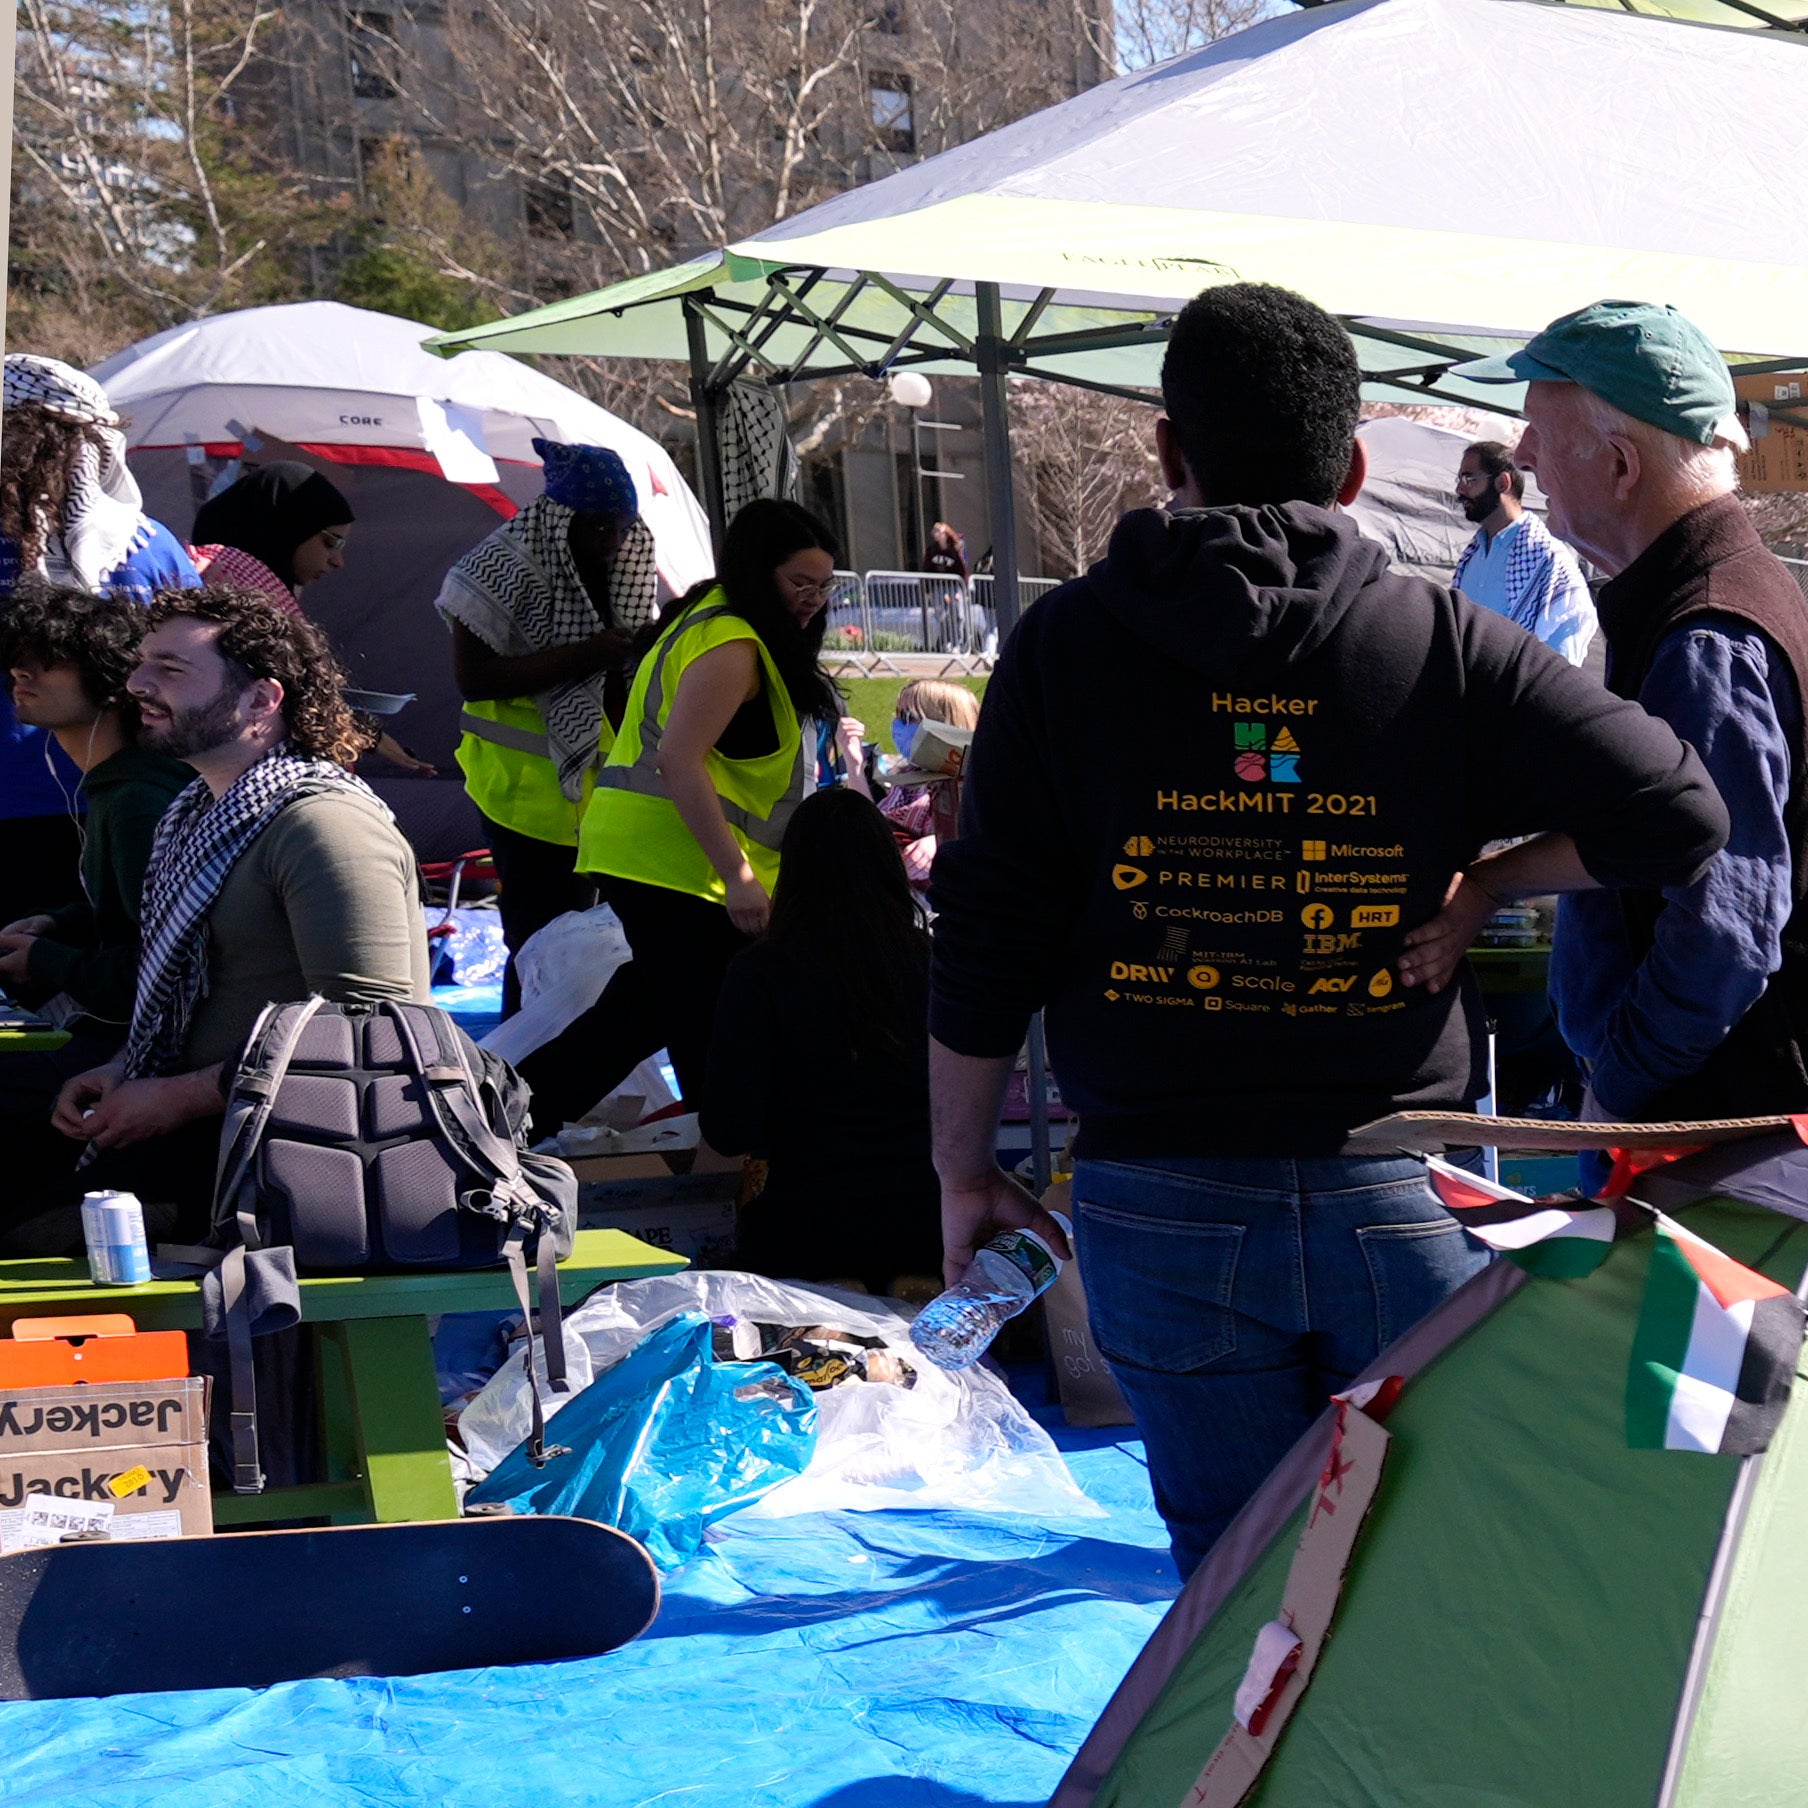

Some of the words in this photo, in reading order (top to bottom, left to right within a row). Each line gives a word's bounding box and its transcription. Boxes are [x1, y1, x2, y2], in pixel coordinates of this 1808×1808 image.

[339, 415, 383, 426] CORE
[1211, 691, 1319, 715] Hacker
[1156, 789, 1296, 814] HackMIT
[1305, 793, 1378, 816] 2021
[1157, 836, 1283, 849] NEURODIVERSITY
[1331, 844, 1405, 859] Microsoft
[1188, 847, 1283, 861] WORKPLACE
[1158, 870, 1287, 890] PREMIER
[1314, 871, 1408, 886] InterSystems
[1154, 905, 1284, 924] CockroachDB
[1359, 911, 1393, 924] HRT
[1302, 932, 1363, 955] IBM
[1110, 960, 1175, 983] DRW
[1231, 975, 1297, 993] scale
[1307, 975, 1360, 995] ACV
[1123, 992, 1153, 1004] TWO
[1155, 994, 1196, 1007] SIGMA
[1225, 999, 1272, 1013] Square
[1299, 1002, 1338, 1014] Gather
[0, 1399, 182, 1437] Jackery
[0, 1468, 185, 1507] Jackry
